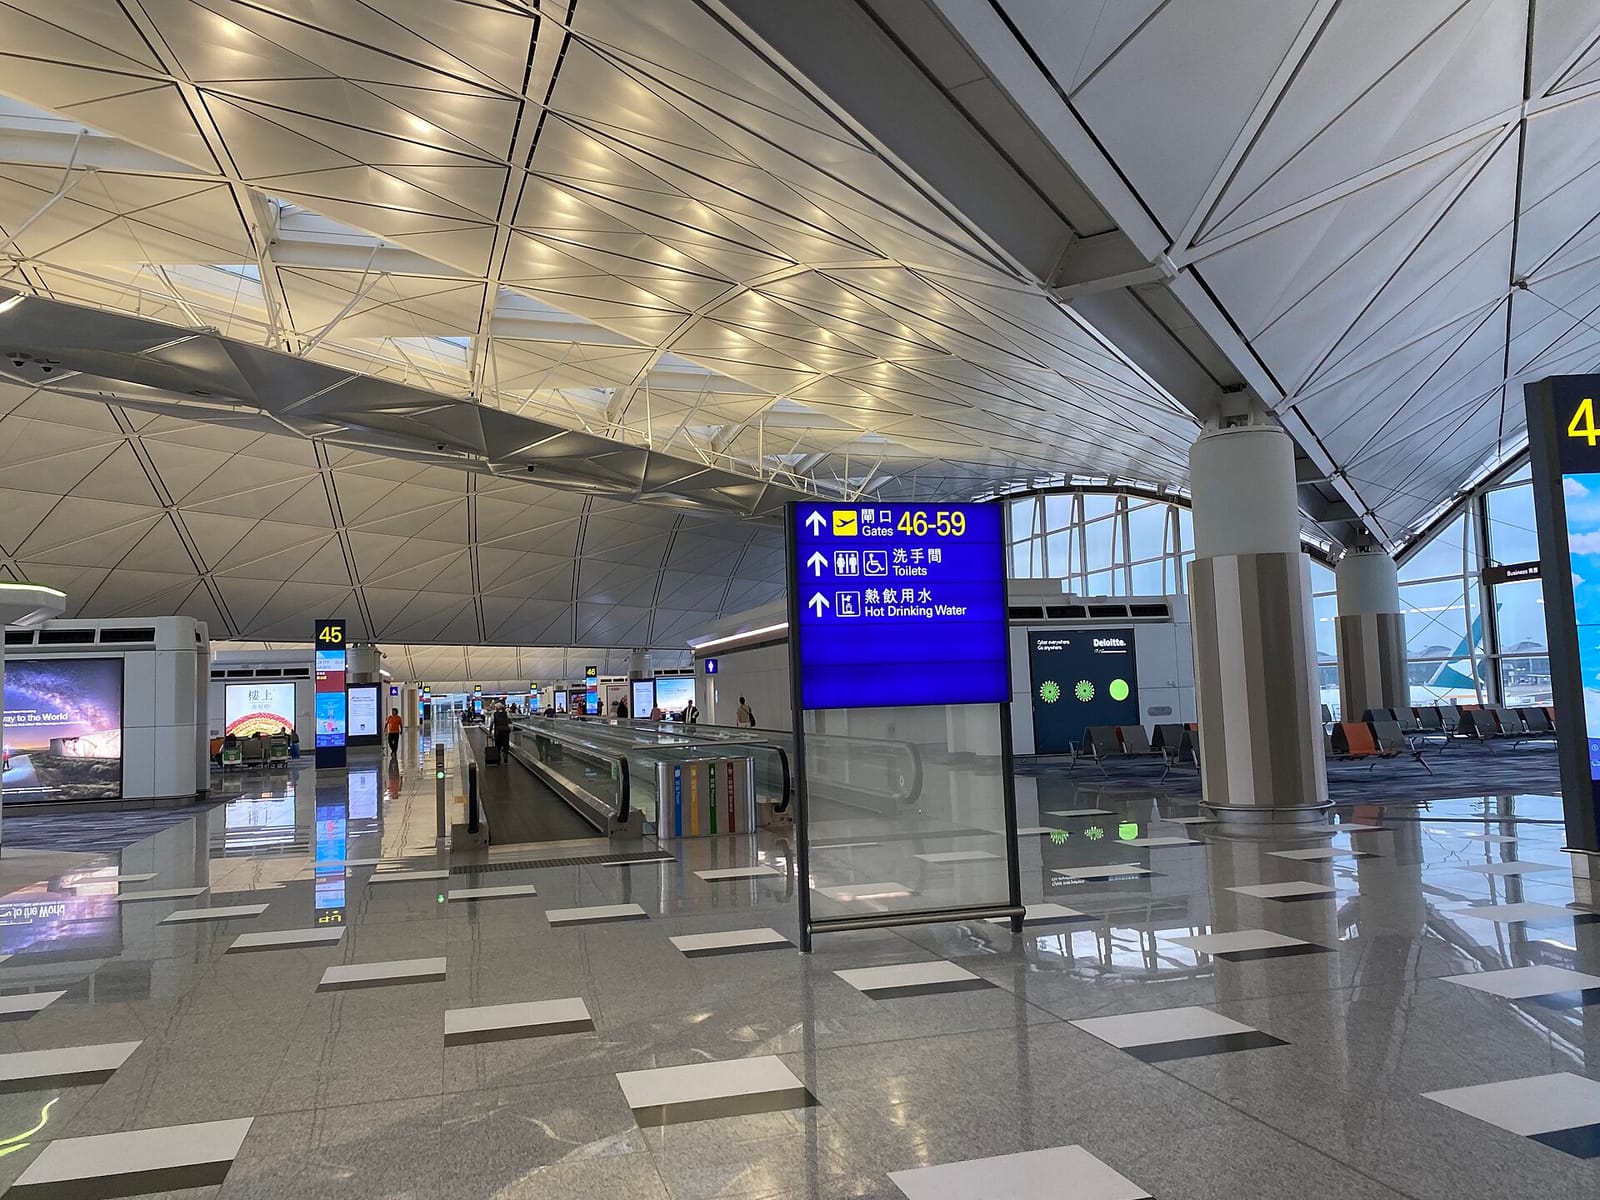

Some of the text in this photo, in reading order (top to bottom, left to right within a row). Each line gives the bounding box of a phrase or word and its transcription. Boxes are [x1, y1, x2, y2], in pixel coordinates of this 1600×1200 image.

[861, 508, 892, 524] 閘口
[897, 511, 966, 537] 46-59
[862, 525, 894, 537] Gates
[892, 548, 942, 564] 洗手間
[892, 565, 928, 576] Toilets
[864, 587, 933, 604] 熱飲用水
[864, 604, 967, 619] Hot Drinking Water
[319, 626, 342, 643] 45
